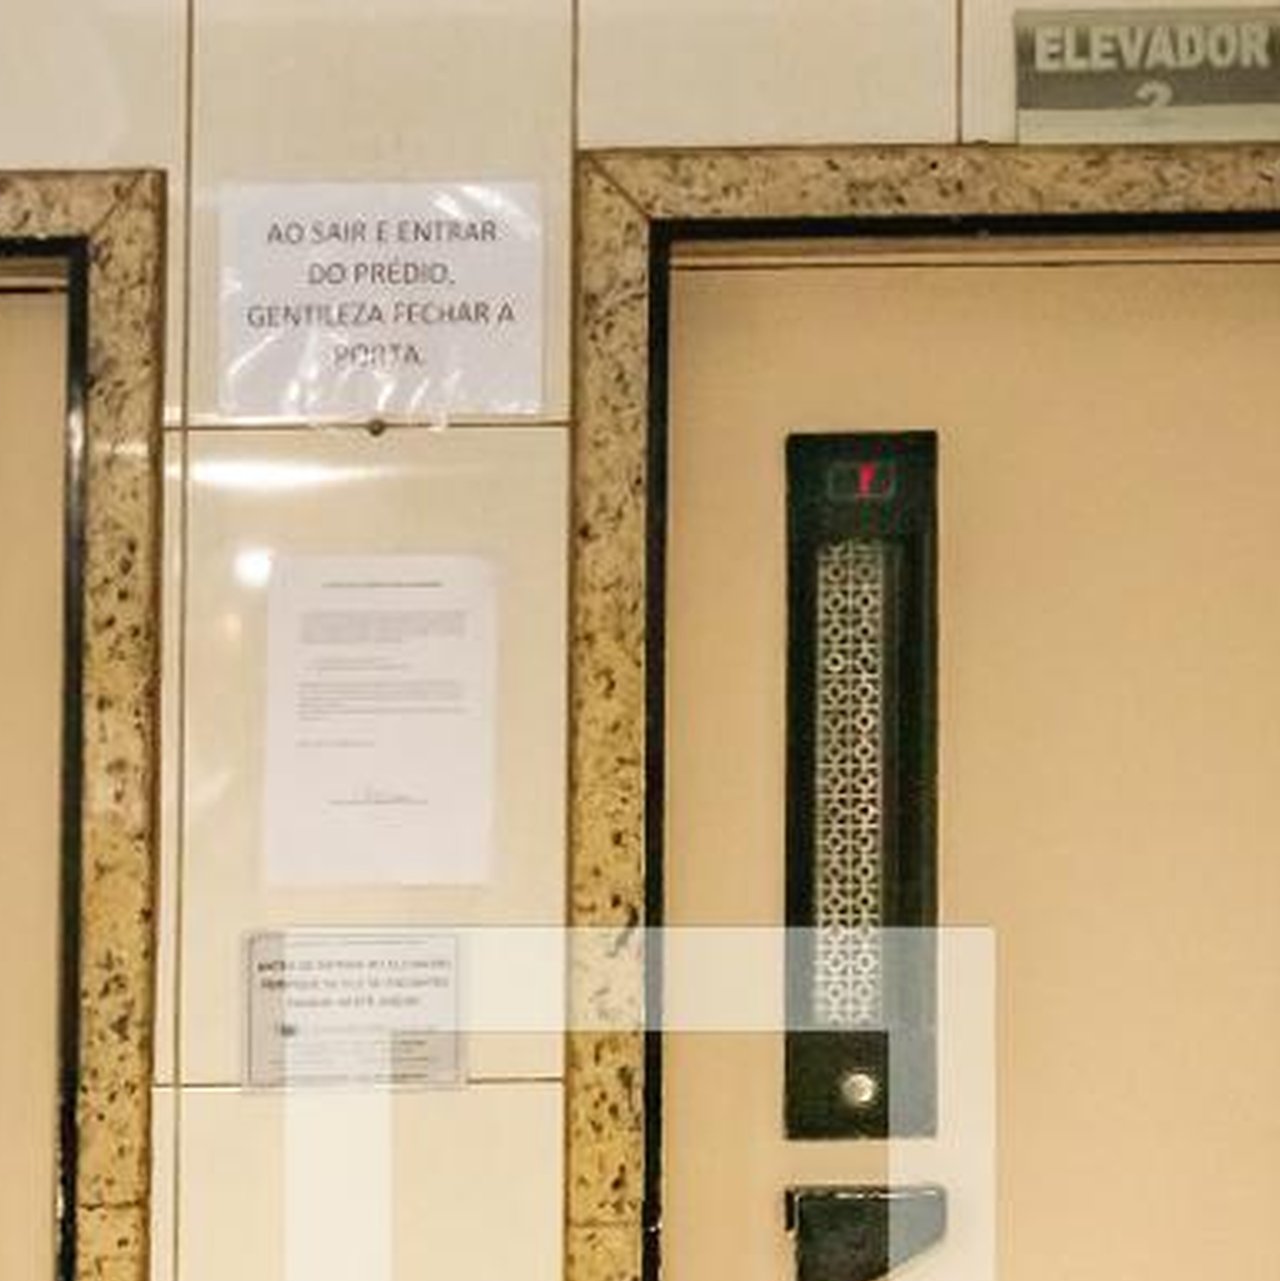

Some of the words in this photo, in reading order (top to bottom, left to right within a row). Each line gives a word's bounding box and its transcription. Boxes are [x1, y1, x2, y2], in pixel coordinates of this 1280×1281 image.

[1034, 21, 1272, 72] ELEVADOR
[267, 220, 305, 245] AO
[310, 219, 367, 244] SAIR
[376, 219, 389, 243] E
[397, 217, 497, 243] ENTRAR
[308, 261, 347, 285] DO
[246, 303, 383, 328] GENTILEZA
[392, 301, 489, 325] FECHAR
[496, 300, 517, 323] A
